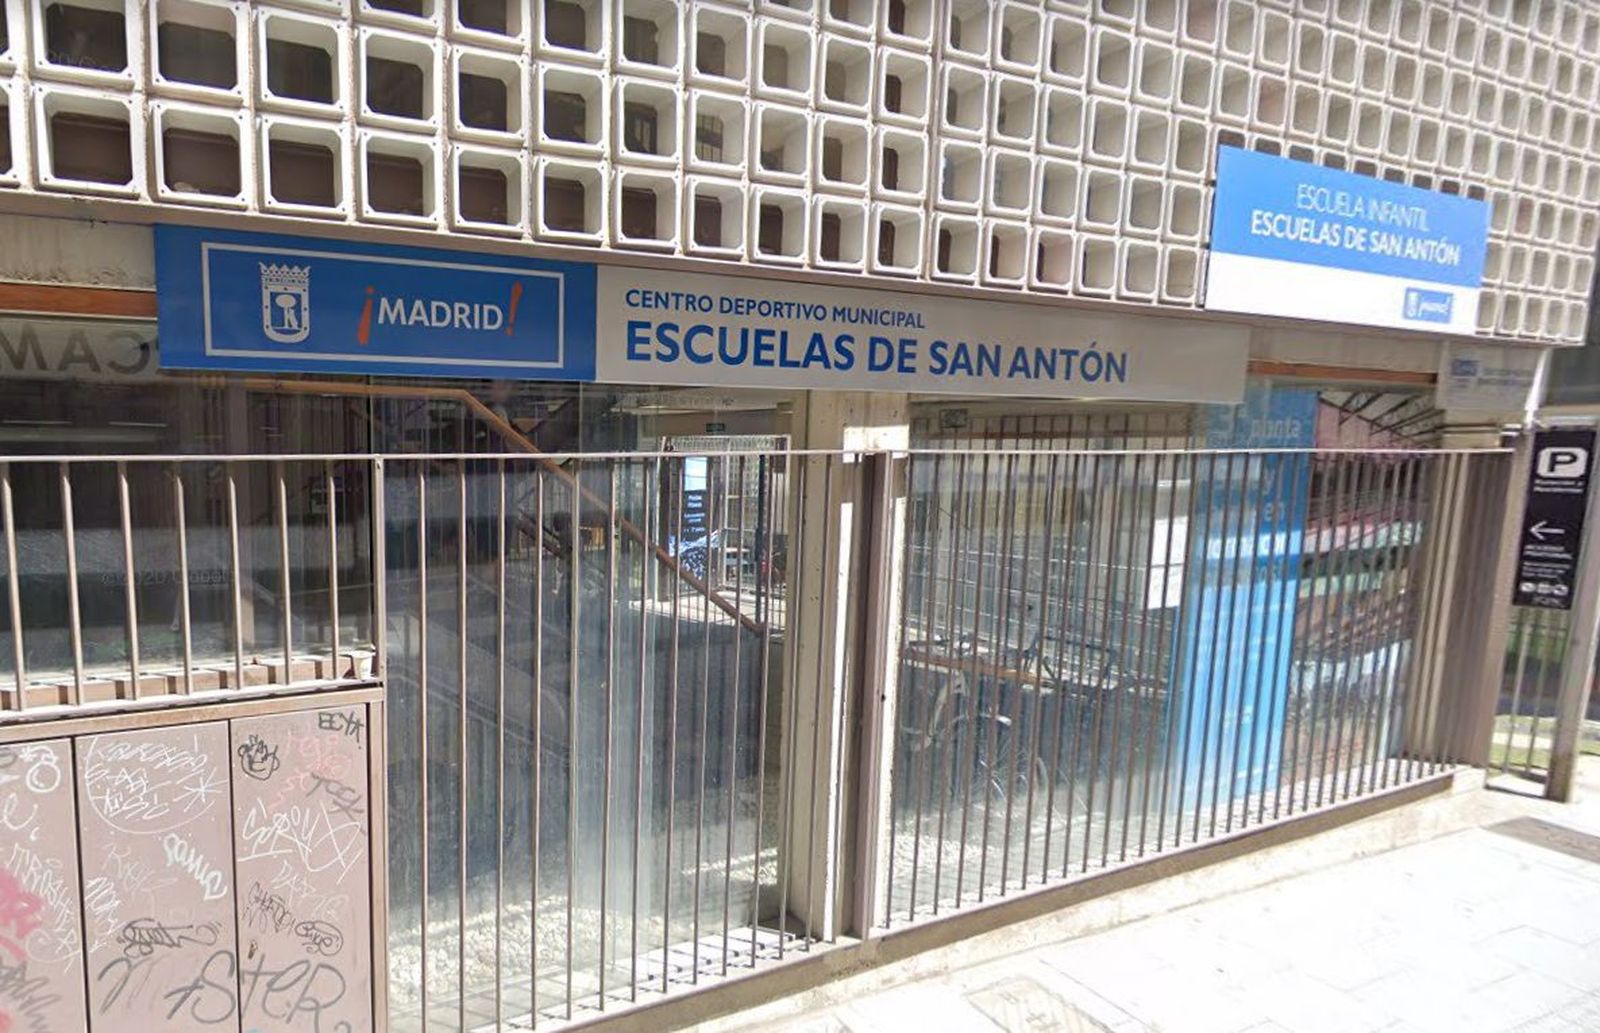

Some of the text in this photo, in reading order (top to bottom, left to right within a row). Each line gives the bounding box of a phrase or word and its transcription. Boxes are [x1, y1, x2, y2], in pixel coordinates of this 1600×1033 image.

[1296, 183, 1430, 232] ESCUELA INFANTIL
[1250, 209, 1461, 266] ESCUELAS DE SAN ANTÓN
[625, 289, 926, 329] CENTRO DEPORTIVO MUNICIPAL
[626, 320, 1127, 383] ESCUELAS DE SAN ANTÓN
